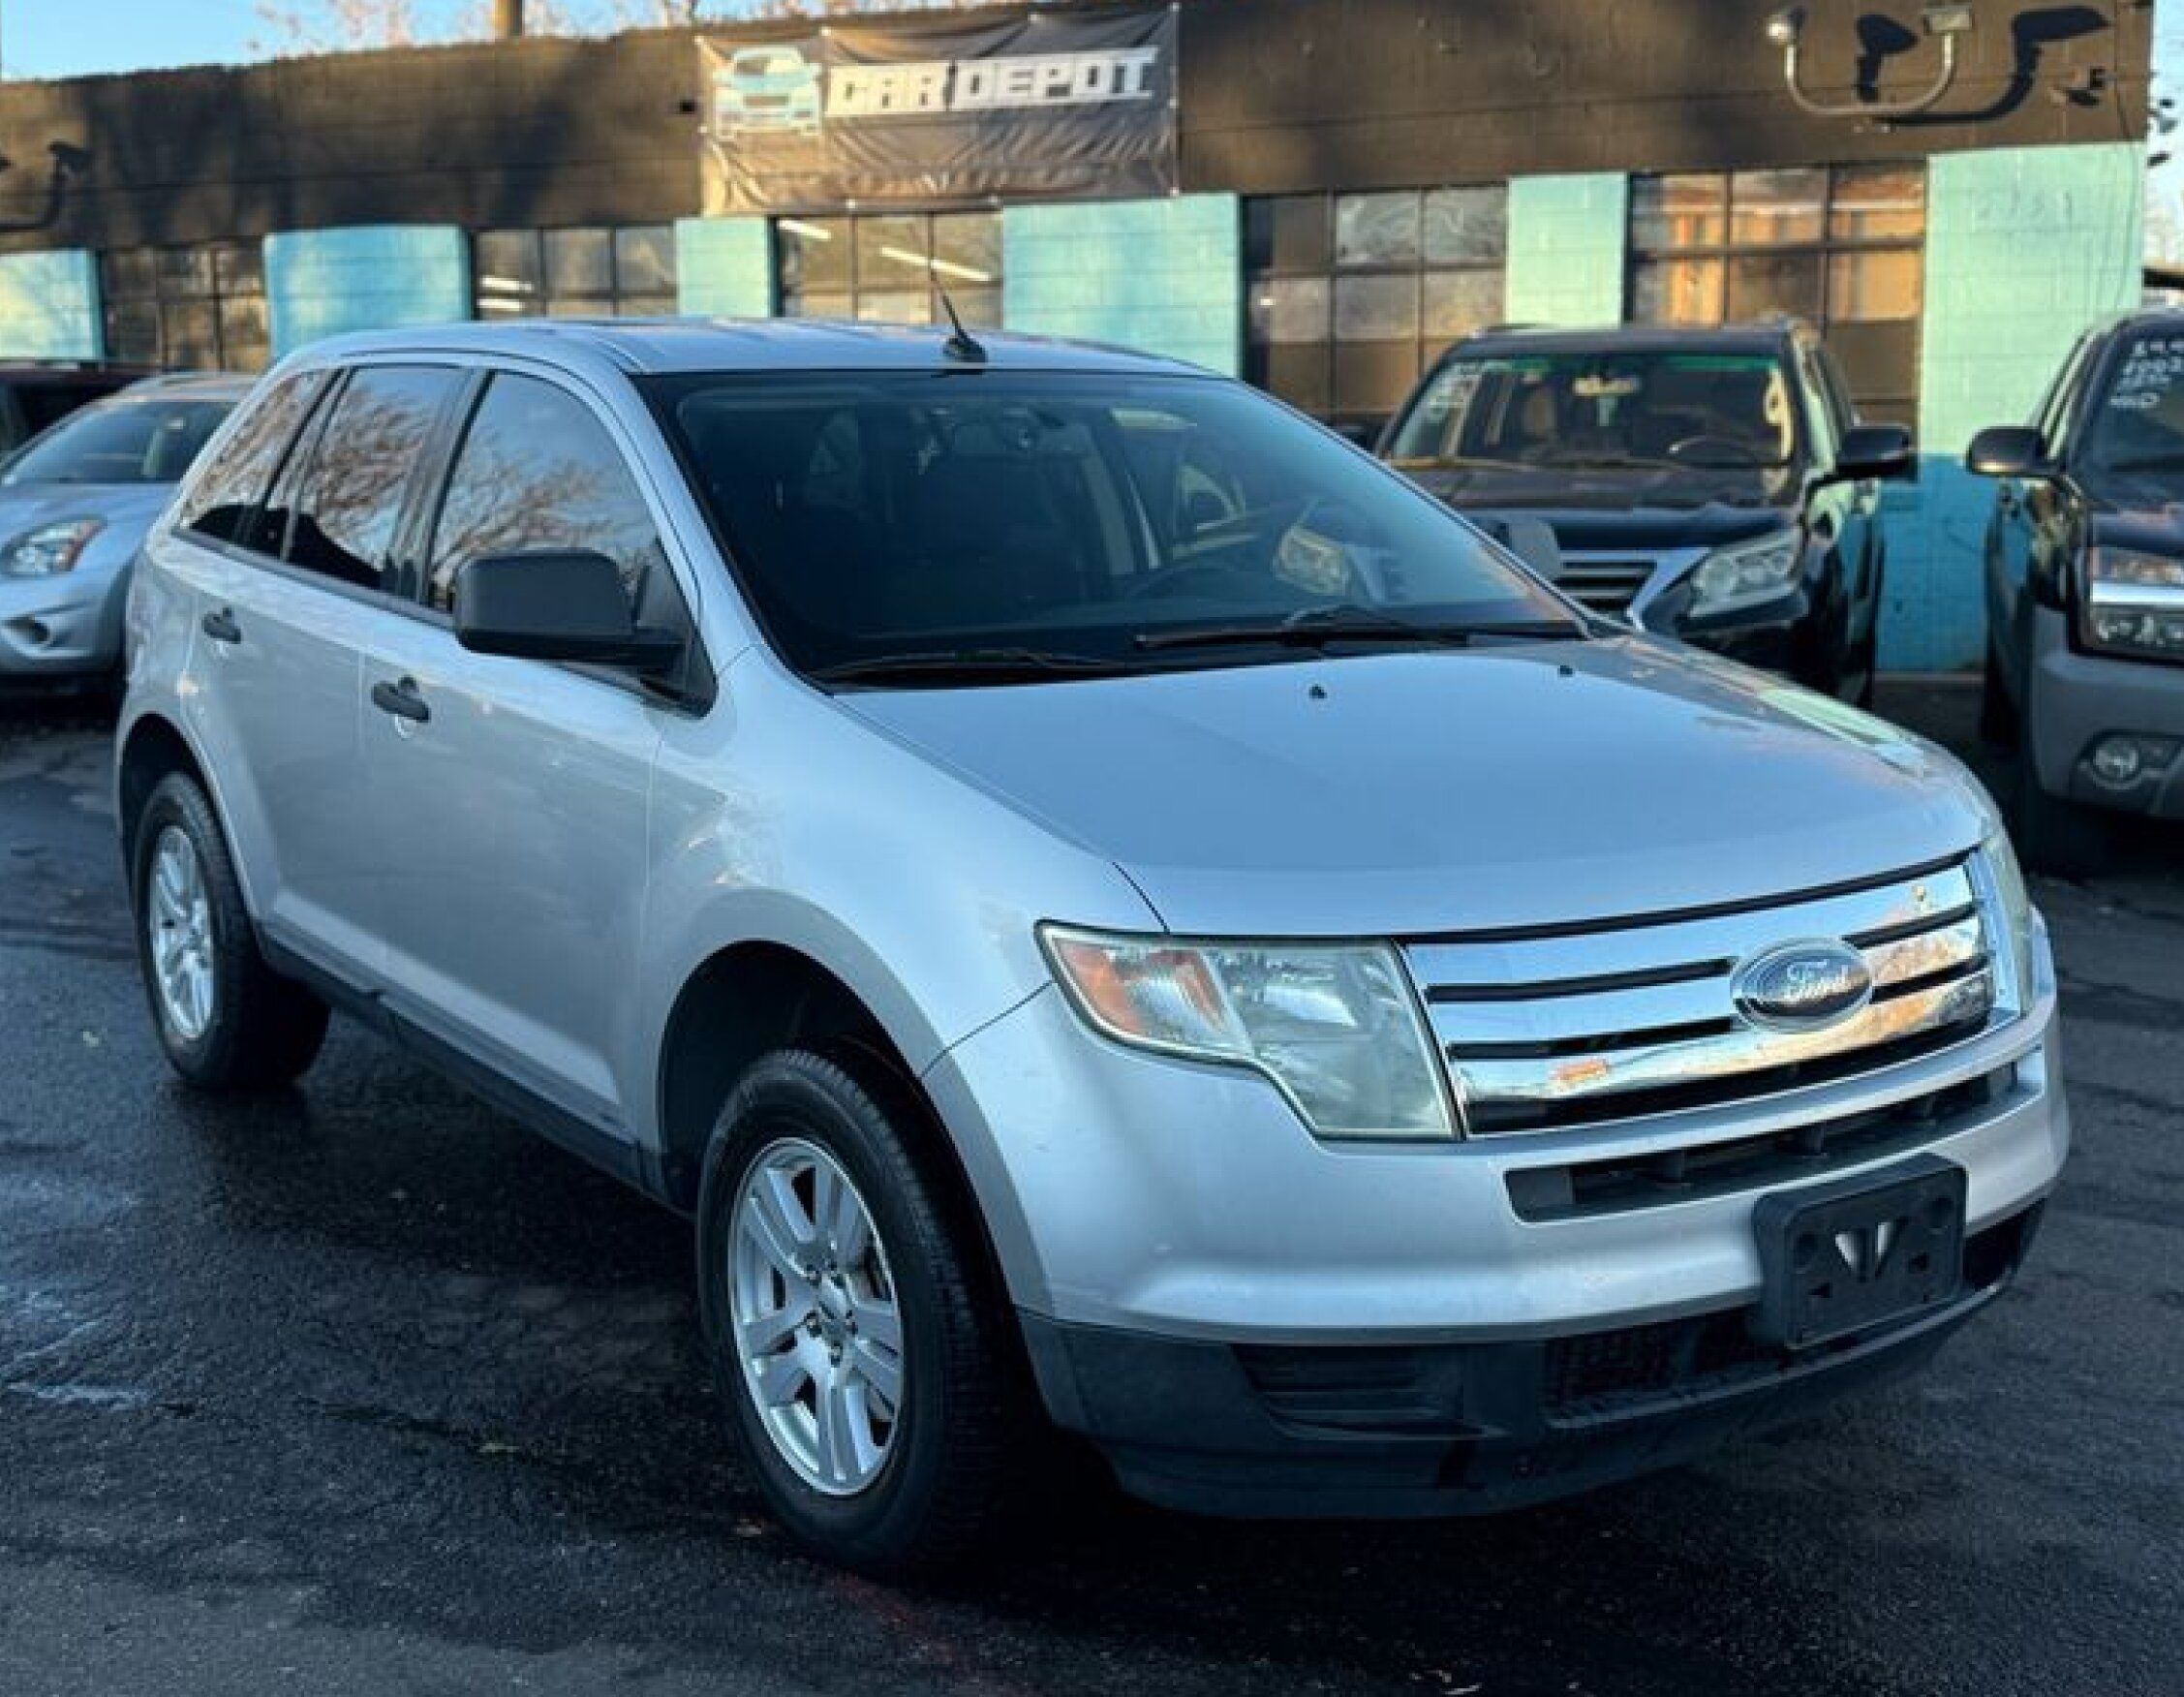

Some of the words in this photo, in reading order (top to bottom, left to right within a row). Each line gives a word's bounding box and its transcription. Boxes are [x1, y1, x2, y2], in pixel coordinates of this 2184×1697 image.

[825, 63, 948, 116] CAR
[952, 47, 1159, 108] DEPOT
[1785, 959, 1849, 1001] Ford
